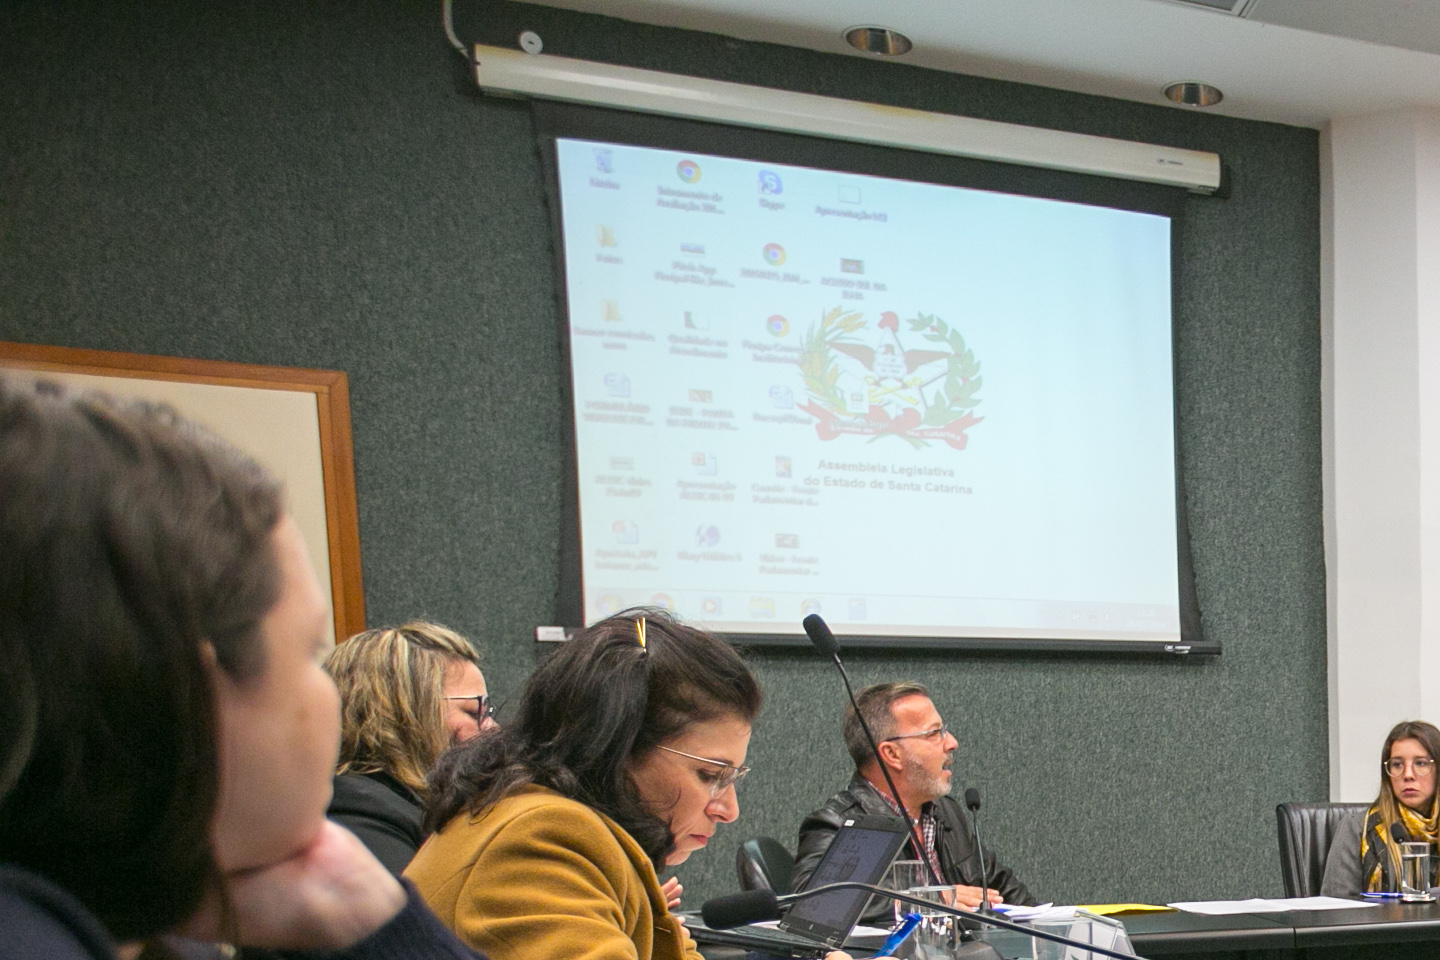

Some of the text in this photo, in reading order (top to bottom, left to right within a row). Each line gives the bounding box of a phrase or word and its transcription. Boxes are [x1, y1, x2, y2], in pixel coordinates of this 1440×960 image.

[818, 459, 955, 478] Assembleia Legislativa
[804, 476, 973, 495] do Estado de Santa Catarina
